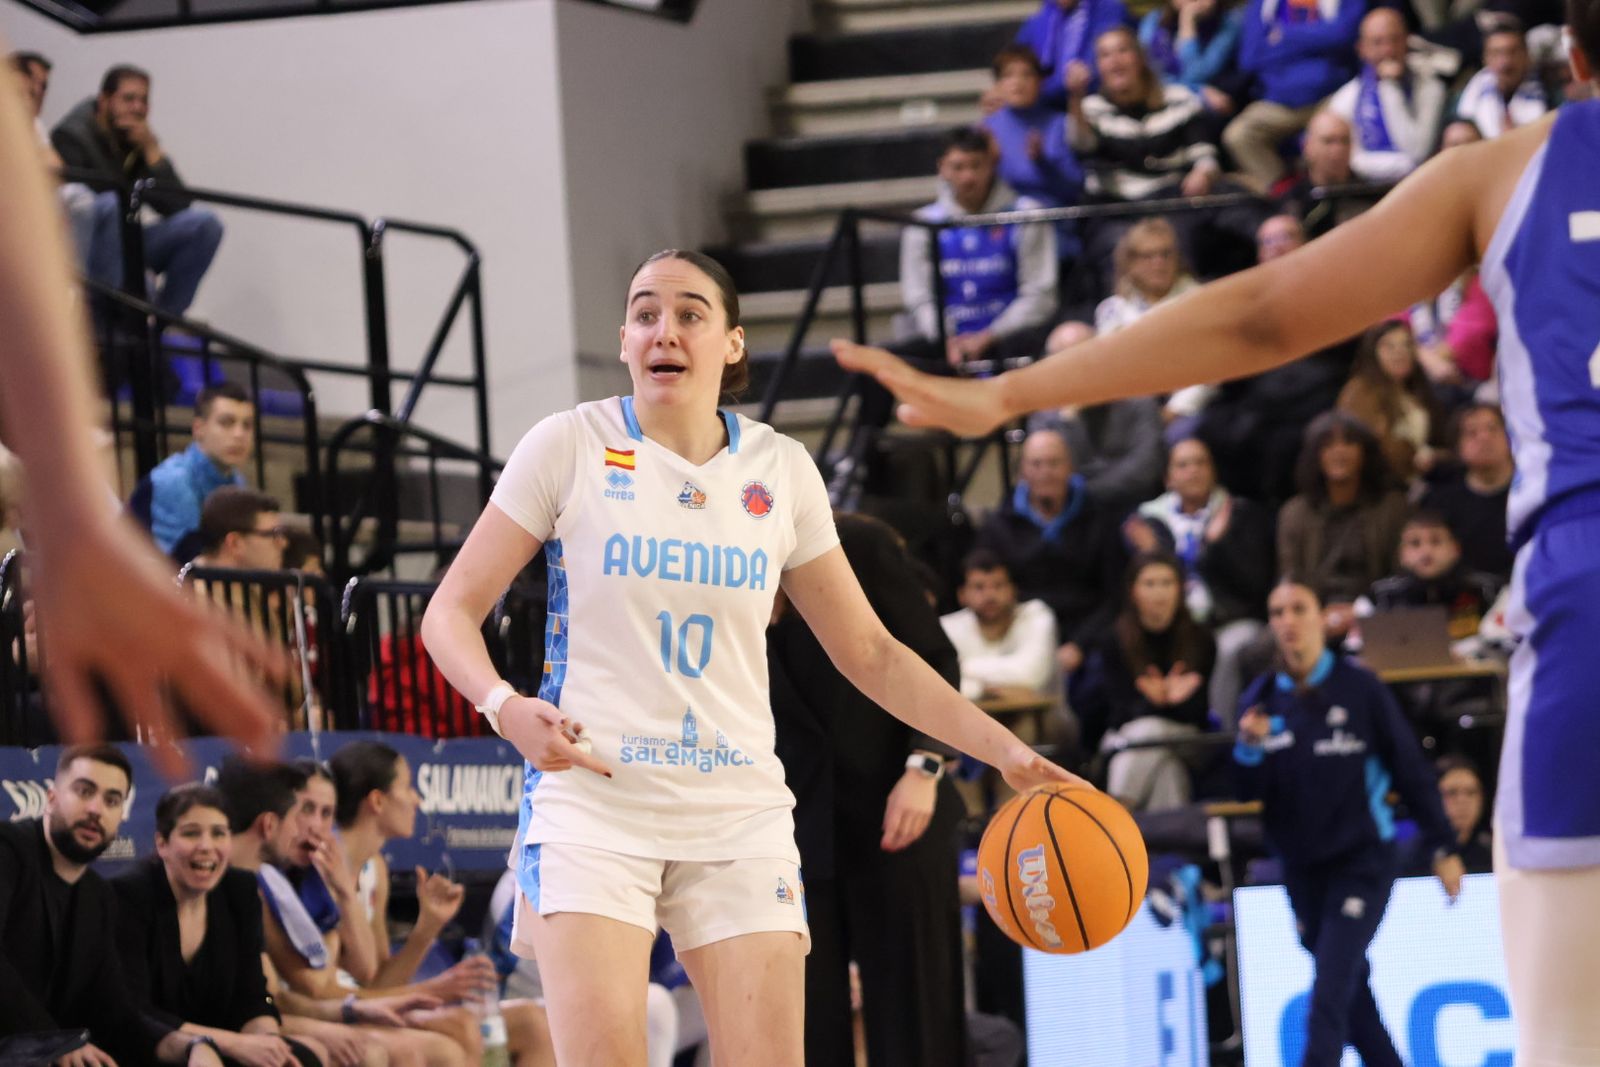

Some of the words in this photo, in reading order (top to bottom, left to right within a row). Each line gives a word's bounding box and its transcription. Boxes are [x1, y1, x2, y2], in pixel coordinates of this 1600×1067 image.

[603, 532, 768, 591] AVENIDA
[656, 609, 714, 679] 10
[621, 734, 666, 746] turismo
